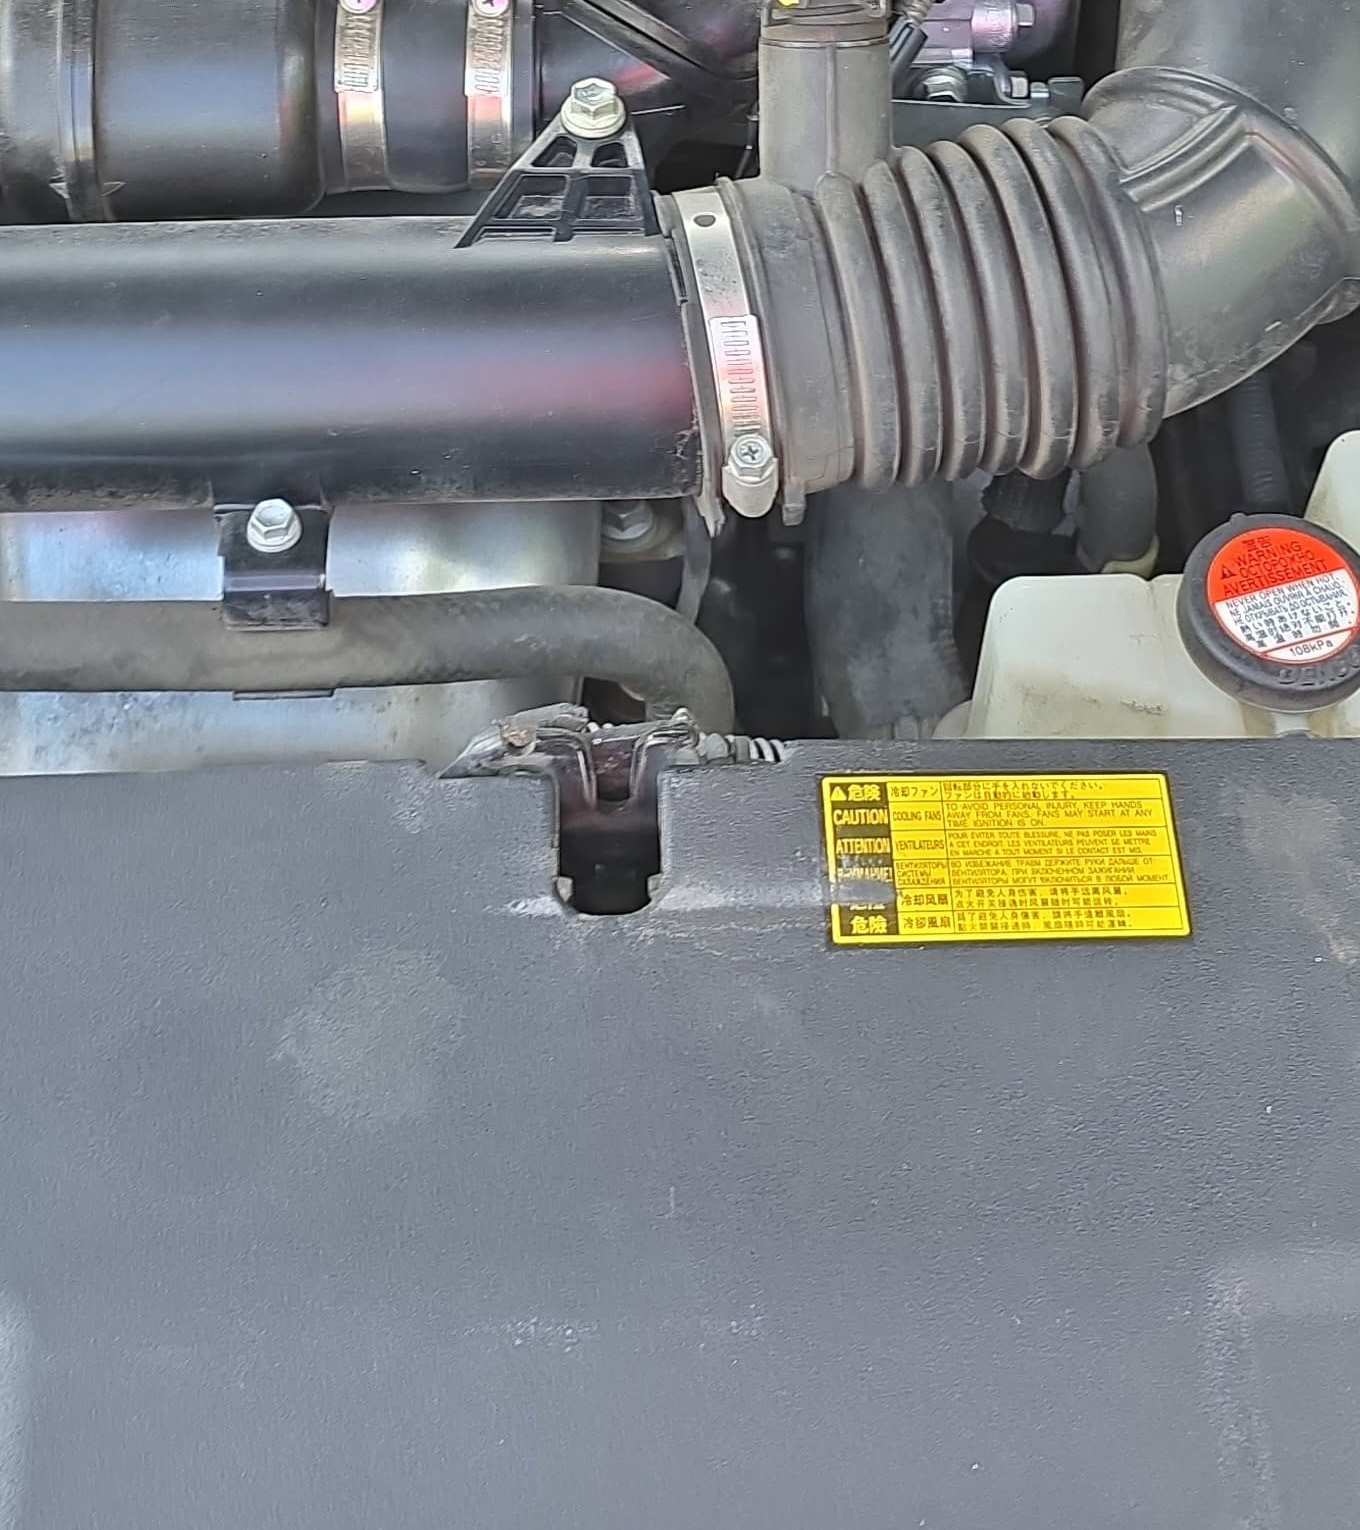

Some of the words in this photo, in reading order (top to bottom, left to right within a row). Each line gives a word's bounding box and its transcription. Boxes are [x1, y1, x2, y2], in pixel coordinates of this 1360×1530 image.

[1235, 542, 1302, 566] WARNING
[1238, 550, 1314, 579] ОСТОРОЖНО
[1223, 560, 1328, 596] AVERTISSEMENT
[1225, 593, 1257, 608] NEVER
[1258, 586, 1284, 599] OPEN
[1285, 579, 1314, 592] WHEN
[1314, 572, 1339, 584] HOT.
[1228, 608, 1241, 616] NE
[1243, 599, 1272, 613] JAMAIS
[1272, 590, 1304, 605] OUVRIR
[1288, 639, 1333, 655] 108kPa
[846, 784, 881, 800] 危険
[890, 786, 938, 797] 冷却ファン
[945, 802, 958, 810] TO
[961, 802, 988, 810] AVOID
[993, 802, 1040, 810] PERSONAL
[1083, 801, 1106, 809] KEEP
[1111, 801, 1142, 809] HANDS
[946, 810, 970, 818] AWAY
[975, 810, 1001, 818] FROM
[1064, 809, 1083, 817] MAY
[1087, 809, 1116, 817] START
[1119, 809, 1130, 817] AT
[1134, 809, 1153, 817] ANY
[832, 808, 888, 825] CAUTION
[892, 810, 921, 821] COOLING
[924, 810, 941, 820] FANS
[947, 819, 968, 827] TIME
[972, 818, 1012, 827] IGNITION
[1016, 818, 1025, 826] IS
[835, 837, 890, 854] ATTENTION
[895, 839, 944, 850] VENTILATEURS
